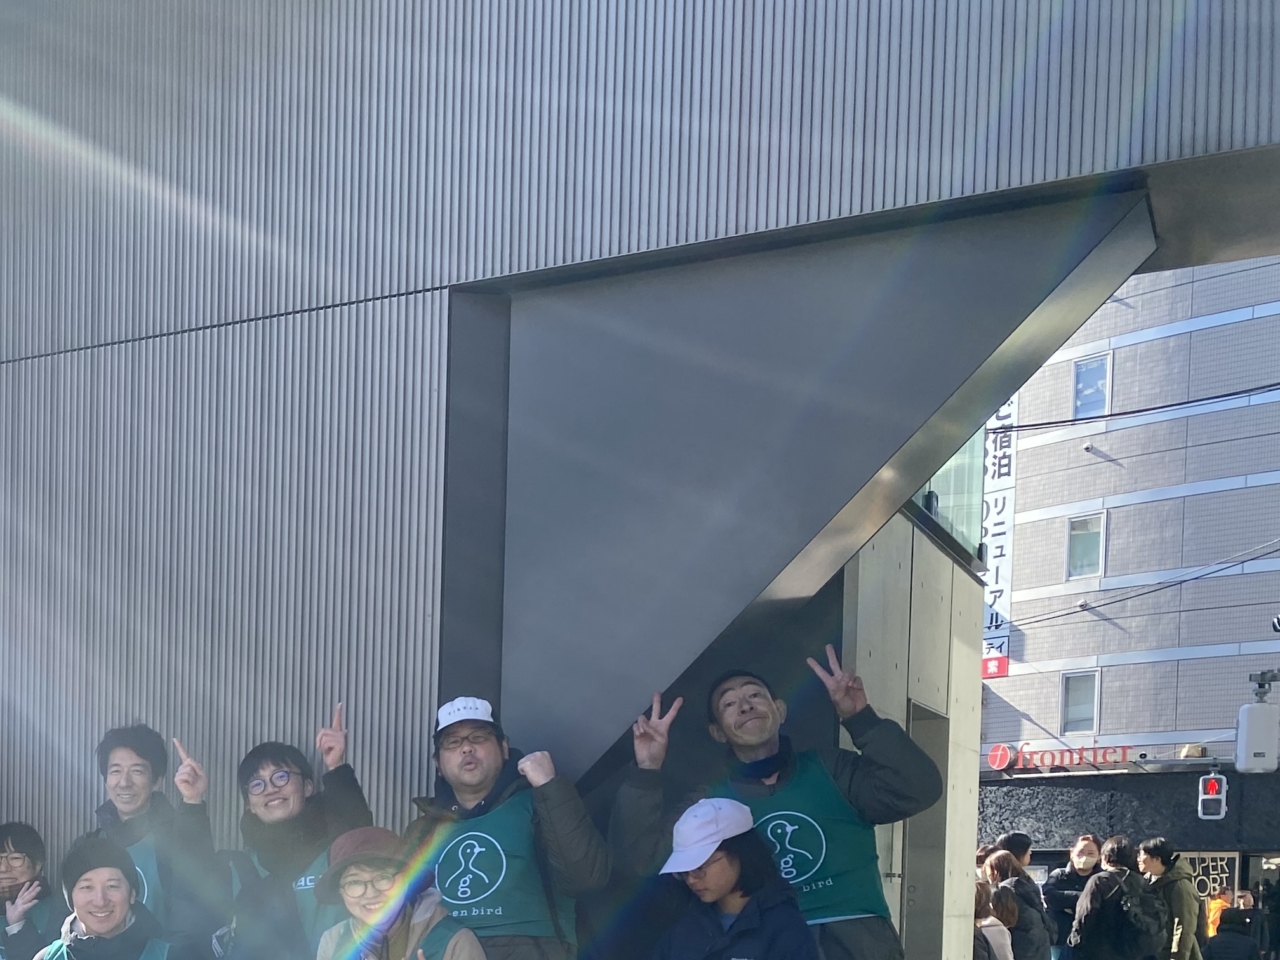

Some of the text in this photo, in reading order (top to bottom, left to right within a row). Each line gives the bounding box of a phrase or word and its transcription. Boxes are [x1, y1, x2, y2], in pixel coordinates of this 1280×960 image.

[987, 496, 1007, 630] リニューアル
[1014, 740, 1134, 769] frontier
[1187, 857, 1230, 876] UPER
[802, 877, 834, 892] bird
[1192, 873, 1230, 896] ORT
[471, 906, 503, 916] bird
